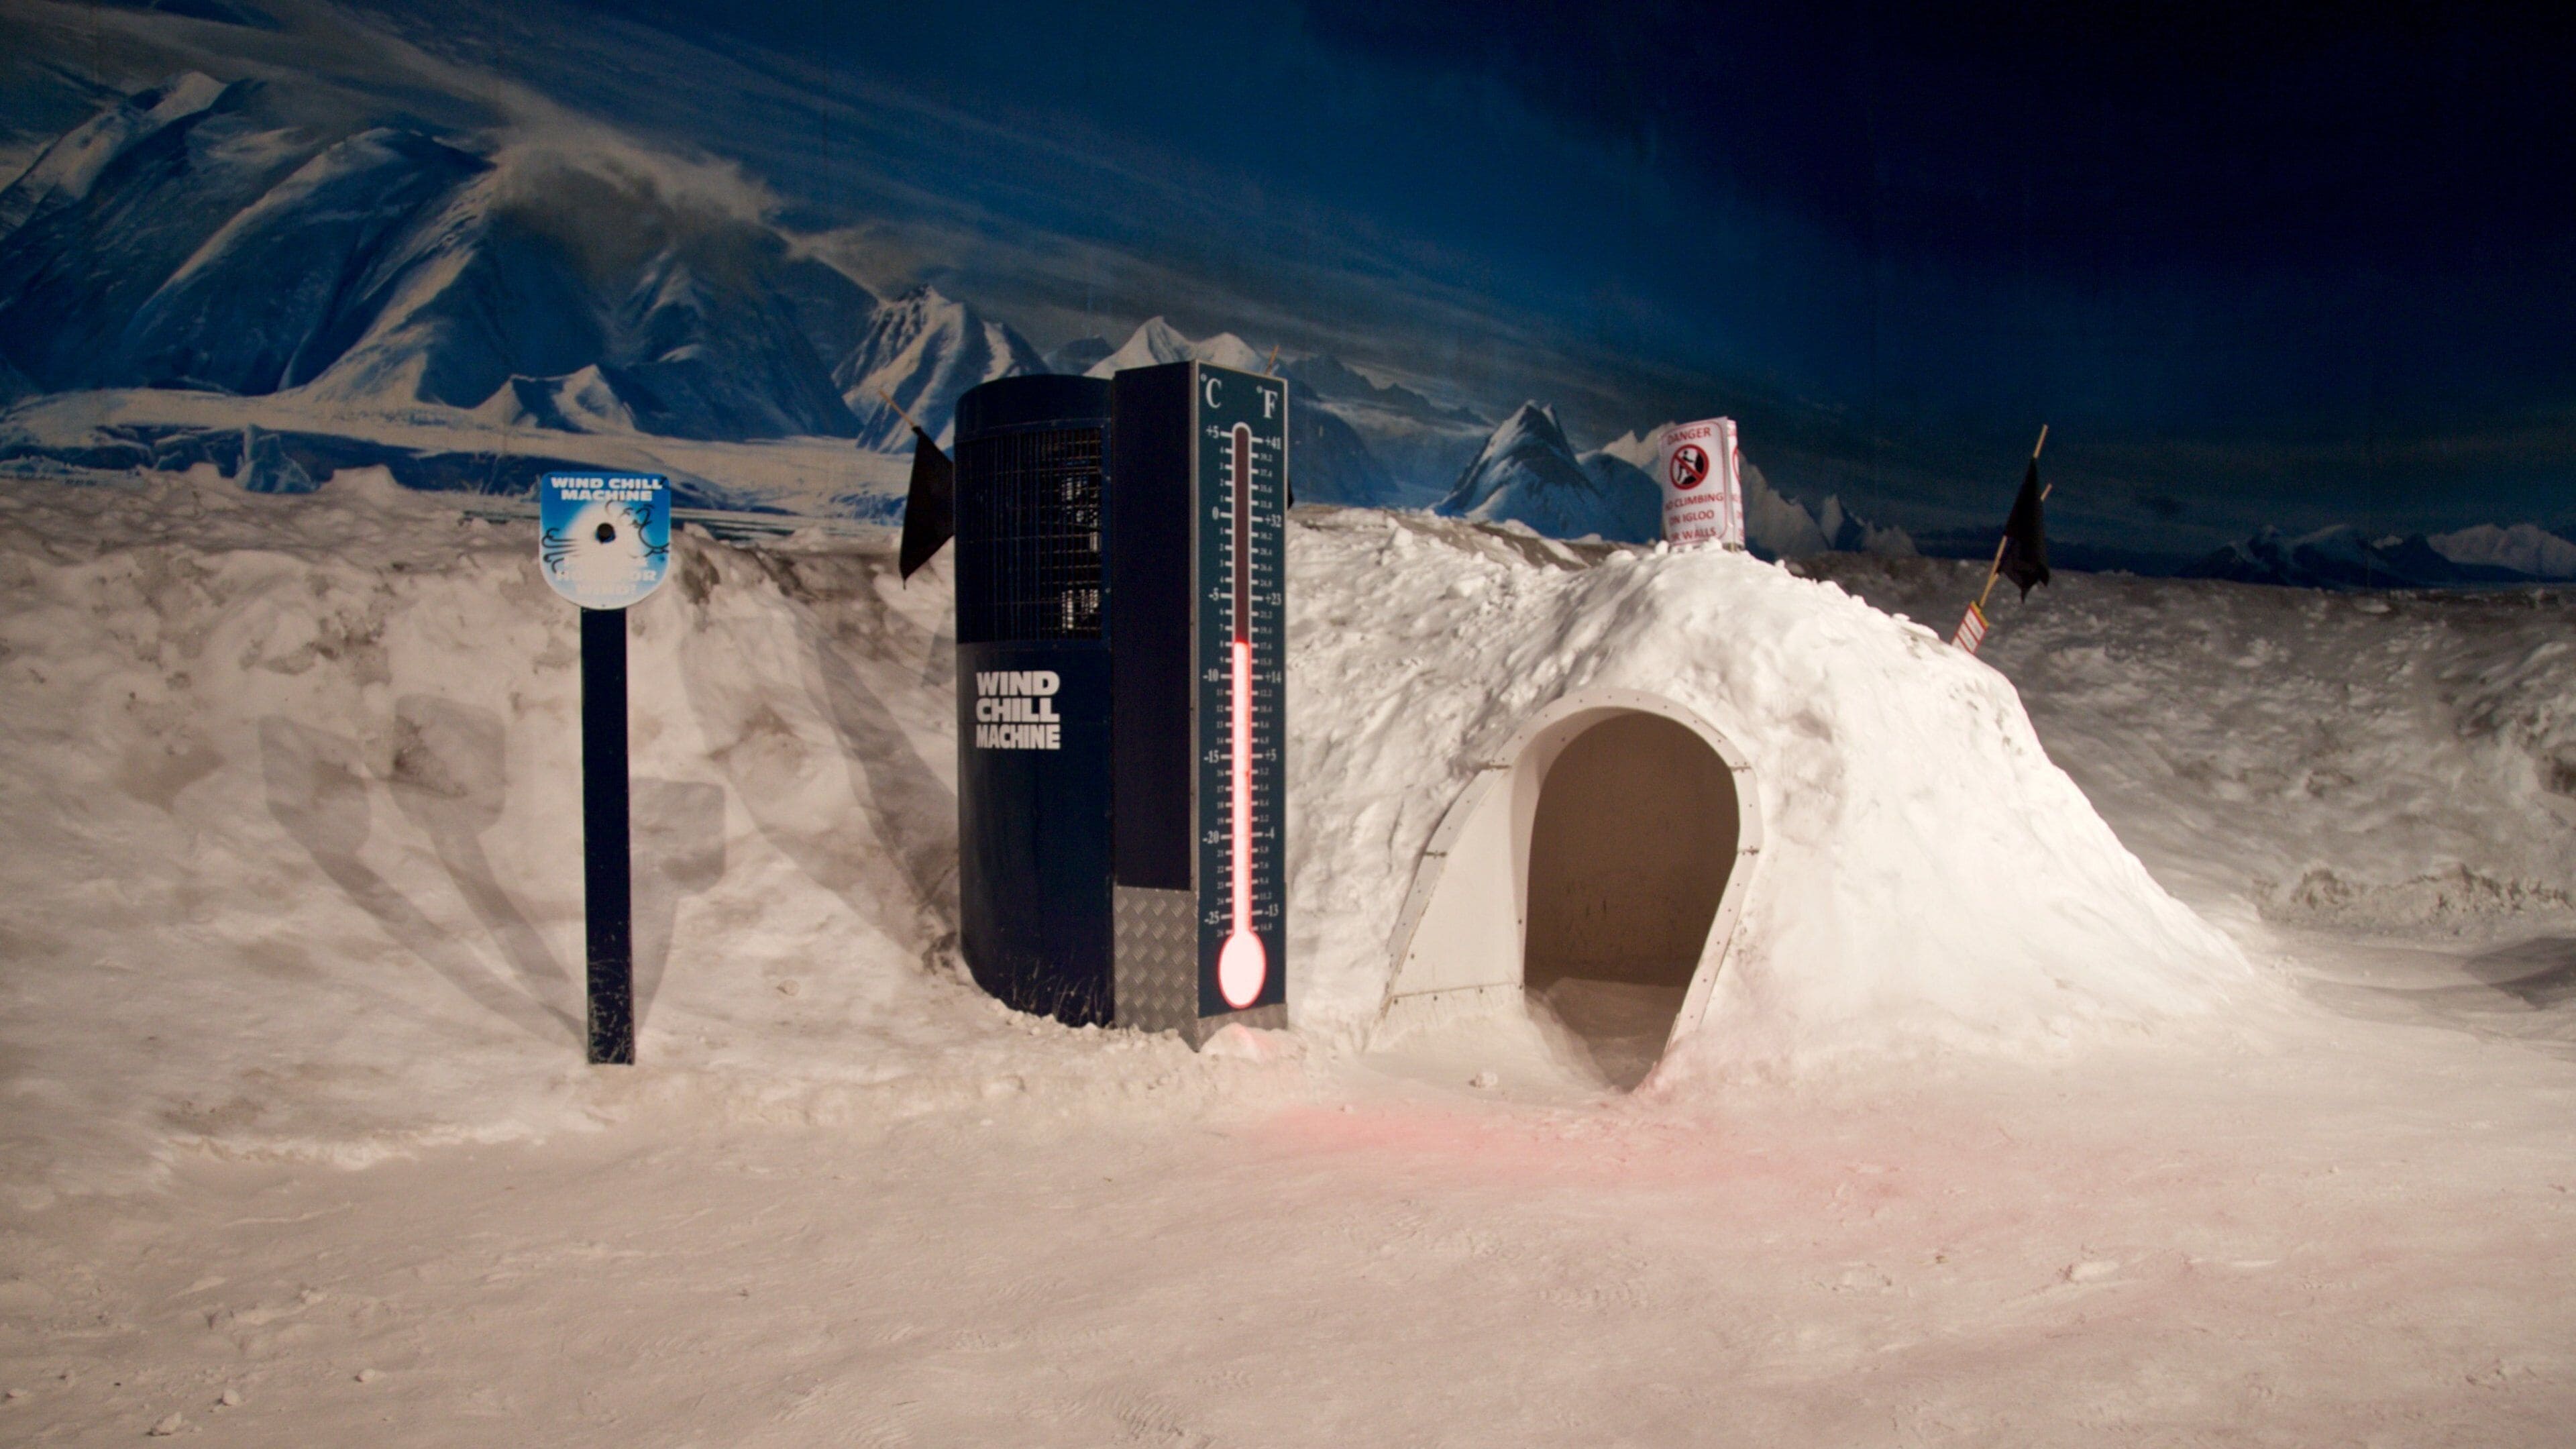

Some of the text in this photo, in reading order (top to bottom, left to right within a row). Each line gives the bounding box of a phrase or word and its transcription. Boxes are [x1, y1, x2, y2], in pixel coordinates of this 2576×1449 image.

[1206, 425, 1219, 439] +5
[1668, 427, 1711, 445] DANGER
[1265, 436, 1281, 449] +41
[551, 477, 662, 490] WIND CHILL
[561, 489, 653, 501] MACHINE
[1674, 492, 1723, 509] CLIMBING
[1212, 506, 1219, 520] 0
[1682, 509, 1714, 523] IGLOO
[1265, 514, 1281, 527] +32
[1682, 527, 1716, 539] WALLS
[1209, 588, 1219, 600] -5
[1265, 592, 1281, 605] +23
[1203, 669, 1218, 682] -10
[1265, 669, 1281, 683] +14
[976, 670, 1060, 696] WIND
[976, 697, 1060, 722] CHILL
[976, 723, 1061, 749] MACHINE
[1203, 750, 1219, 763] -15
[1265, 749, 1277, 761] +5
[1202, 830, 1219, 844] -20
[1265, 826, 1275, 839] -4
[1264, 904, 1279, 916] -13
[1204, 910, 1220, 924] -25
